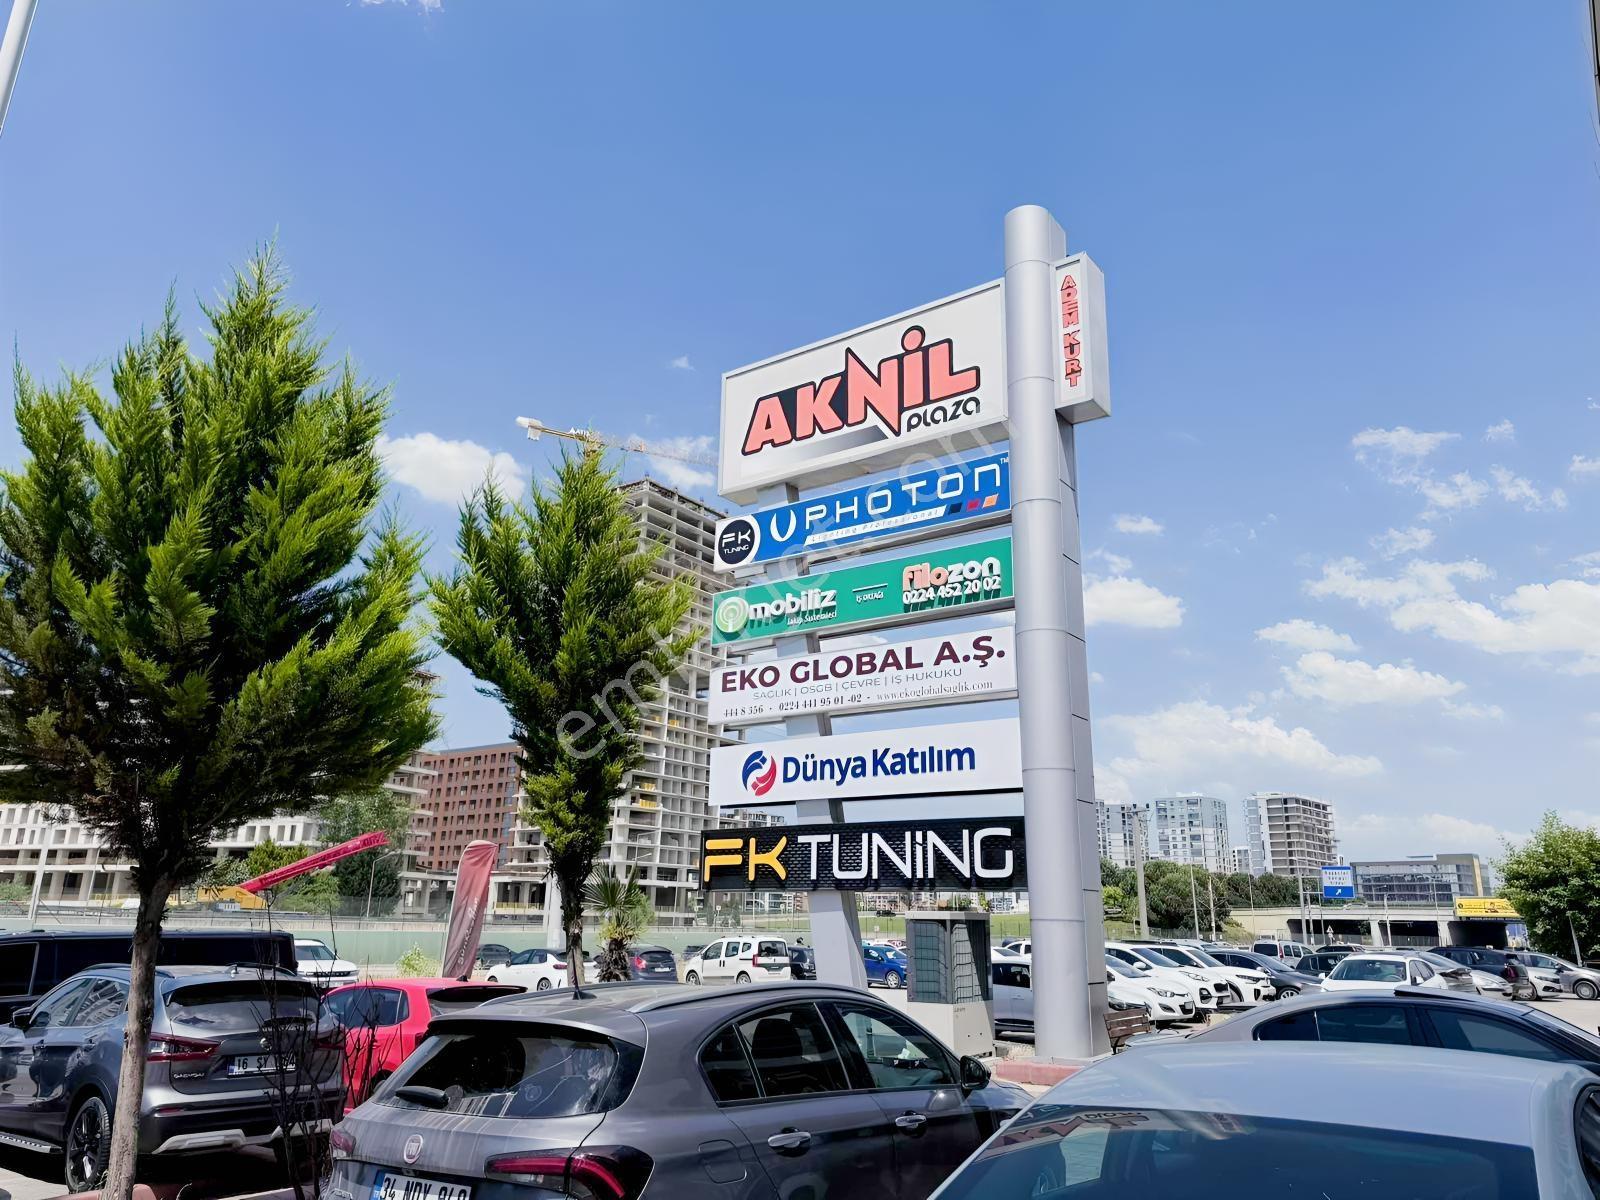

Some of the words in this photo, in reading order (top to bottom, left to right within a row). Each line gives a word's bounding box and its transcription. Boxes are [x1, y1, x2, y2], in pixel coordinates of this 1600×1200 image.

[1060, 274, 1080, 329] ADEM
[1063, 329, 1083, 388] KURT
[906, 396, 981, 433] plaza
[721, 528, 752, 548] FK
[902, 556, 1001, 592] filozon
[902, 588, 936, 605] 0224
[937, 582, 963, 599] 452
[964, 579, 981, 595] 20
[983, 576, 1001, 592] 02
[748, 587, 837, 620] mobiliz
[721, 665, 781, 693] EKO
[789, 647, 924, 684] GLOBAL
[933, 635, 1006, 668] A.Ş.
[800, 683, 833, 695] OSGB
[905, 668, 962, 682] HUKUKU
[778, 700, 799, 711] 0224
[833, 695, 844, 705] 01
[782, 753, 867, 786] Dünya
[871, 745, 976, 777] Katılım
[703, 835, 788, 883] FK
[380, 1176, 397, 1200] 34
